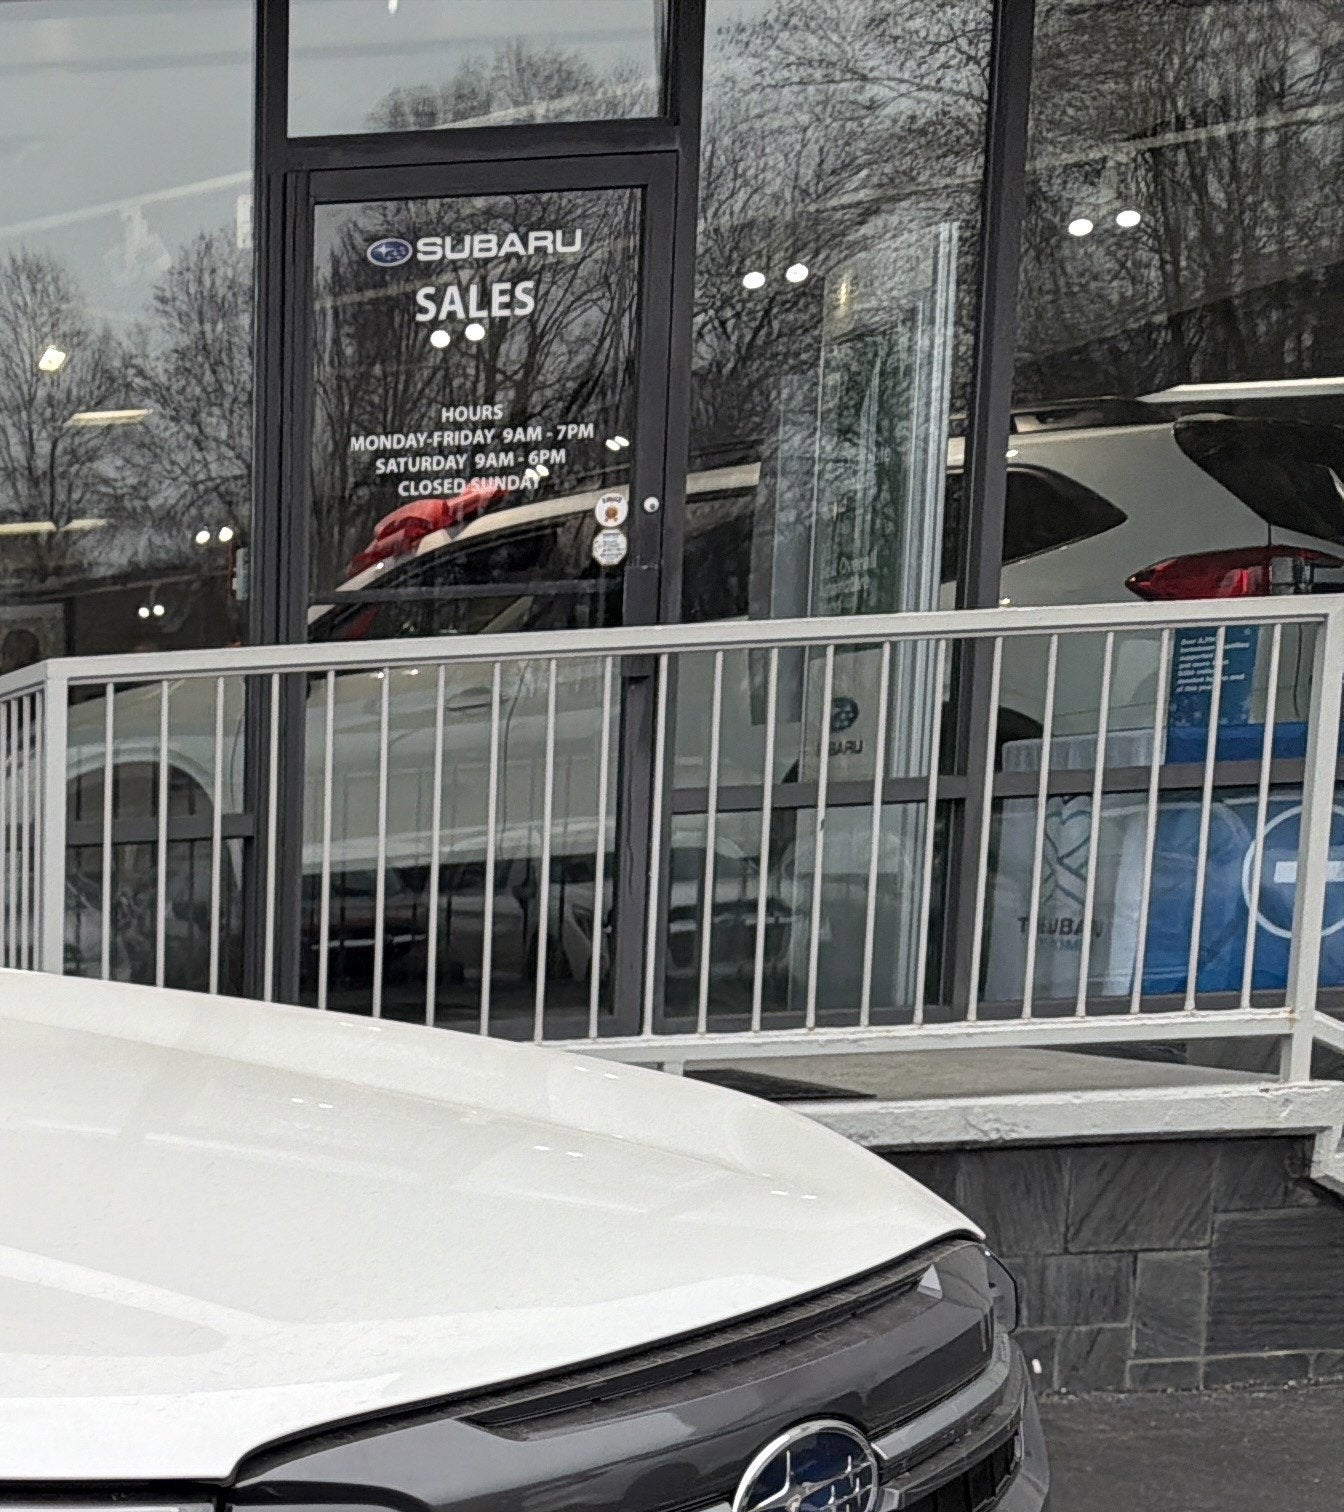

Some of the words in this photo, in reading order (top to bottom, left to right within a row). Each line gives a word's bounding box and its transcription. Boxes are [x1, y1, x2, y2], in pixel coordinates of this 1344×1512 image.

[416, 228, 584, 263] SUBARU
[414, 280, 536, 323] SALES
[441, 403, 504, 423] HOURS
[349, 428, 496, 453] MONDAY-FRIDAY
[502, 425, 543, 445] 9AM
[556, 422, 595, 441] 7PM
[374, 452, 468, 476] SATURDAY
[474, 451, 515, 470] 9AM
[528, 448, 567, 467] 6PM
[397, 477, 466, 498] CLOSED
[469, 473, 541, 494] SUNDAY
